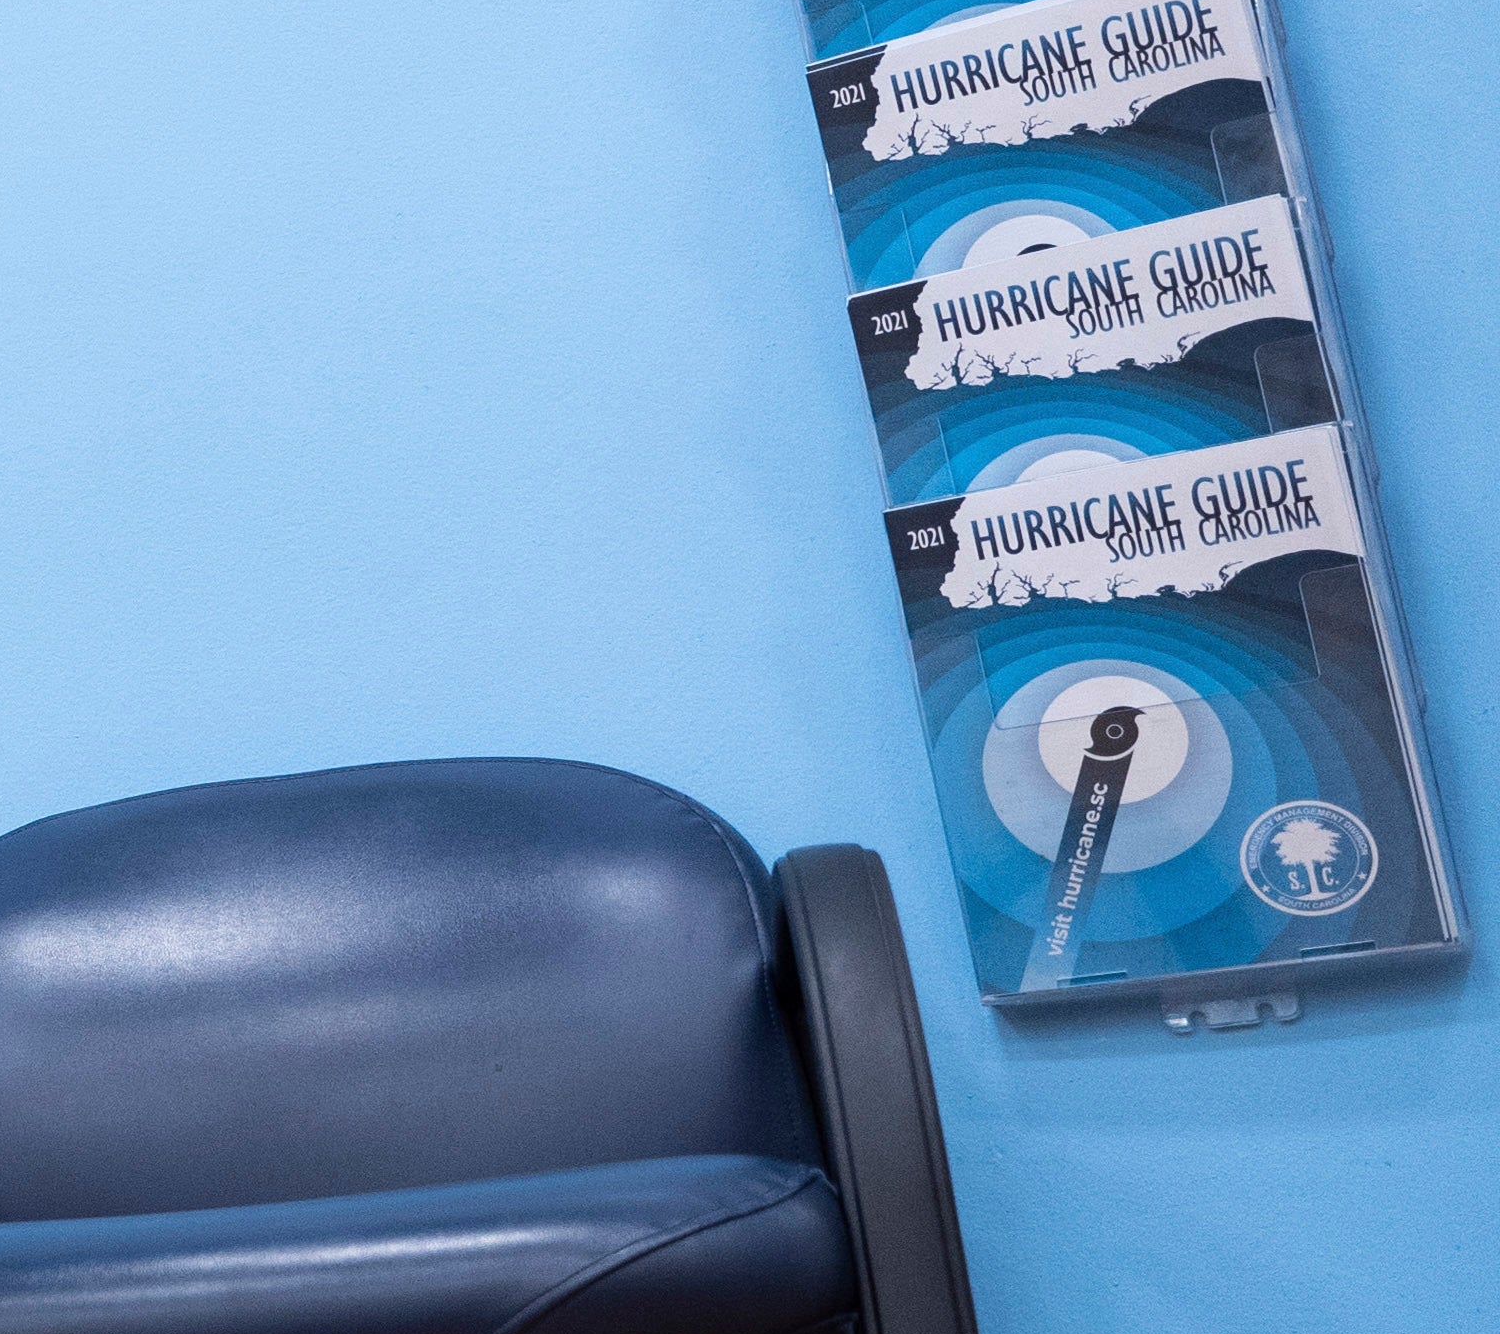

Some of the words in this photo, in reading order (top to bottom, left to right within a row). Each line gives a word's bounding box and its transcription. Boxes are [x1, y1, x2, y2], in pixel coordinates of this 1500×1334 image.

[890, 26, 1092, 114] HURRICANE
[1019, 59, 1097, 107] SOUTH
[1108, 29, 1226, 83] CAROLINA
[829, 82, 866, 109] 2021
[933, 259, 1139, 342] HURRICANE
[1149, 228, 1268, 293] GUIDE
[1065, 293, 1145, 340] SOUTH
[1157, 265, 1277, 318] CAROLINA
[870, 309, 909, 335] 2021
[971, 483, 1182, 561] HURRICANE
[1191, 459, 1314, 521] GUIDE
[1105, 520, 1185, 564] SOUTH
[1199, 500, 1321, 547] CAROLINA
[907, 524, 945, 551] 2021
[1274, 807, 1345, 823] MANAGEMENT
[1057, 782, 1108, 910] hurricane.sc
[1278, 896, 1310, 910] SOUTH
[1311, 888, 1357, 910] CAROLINA
[1288, 871, 1306, 890] S.
[1322, 867, 1340, 886] C.
[1048, 913, 1073, 956] visit
